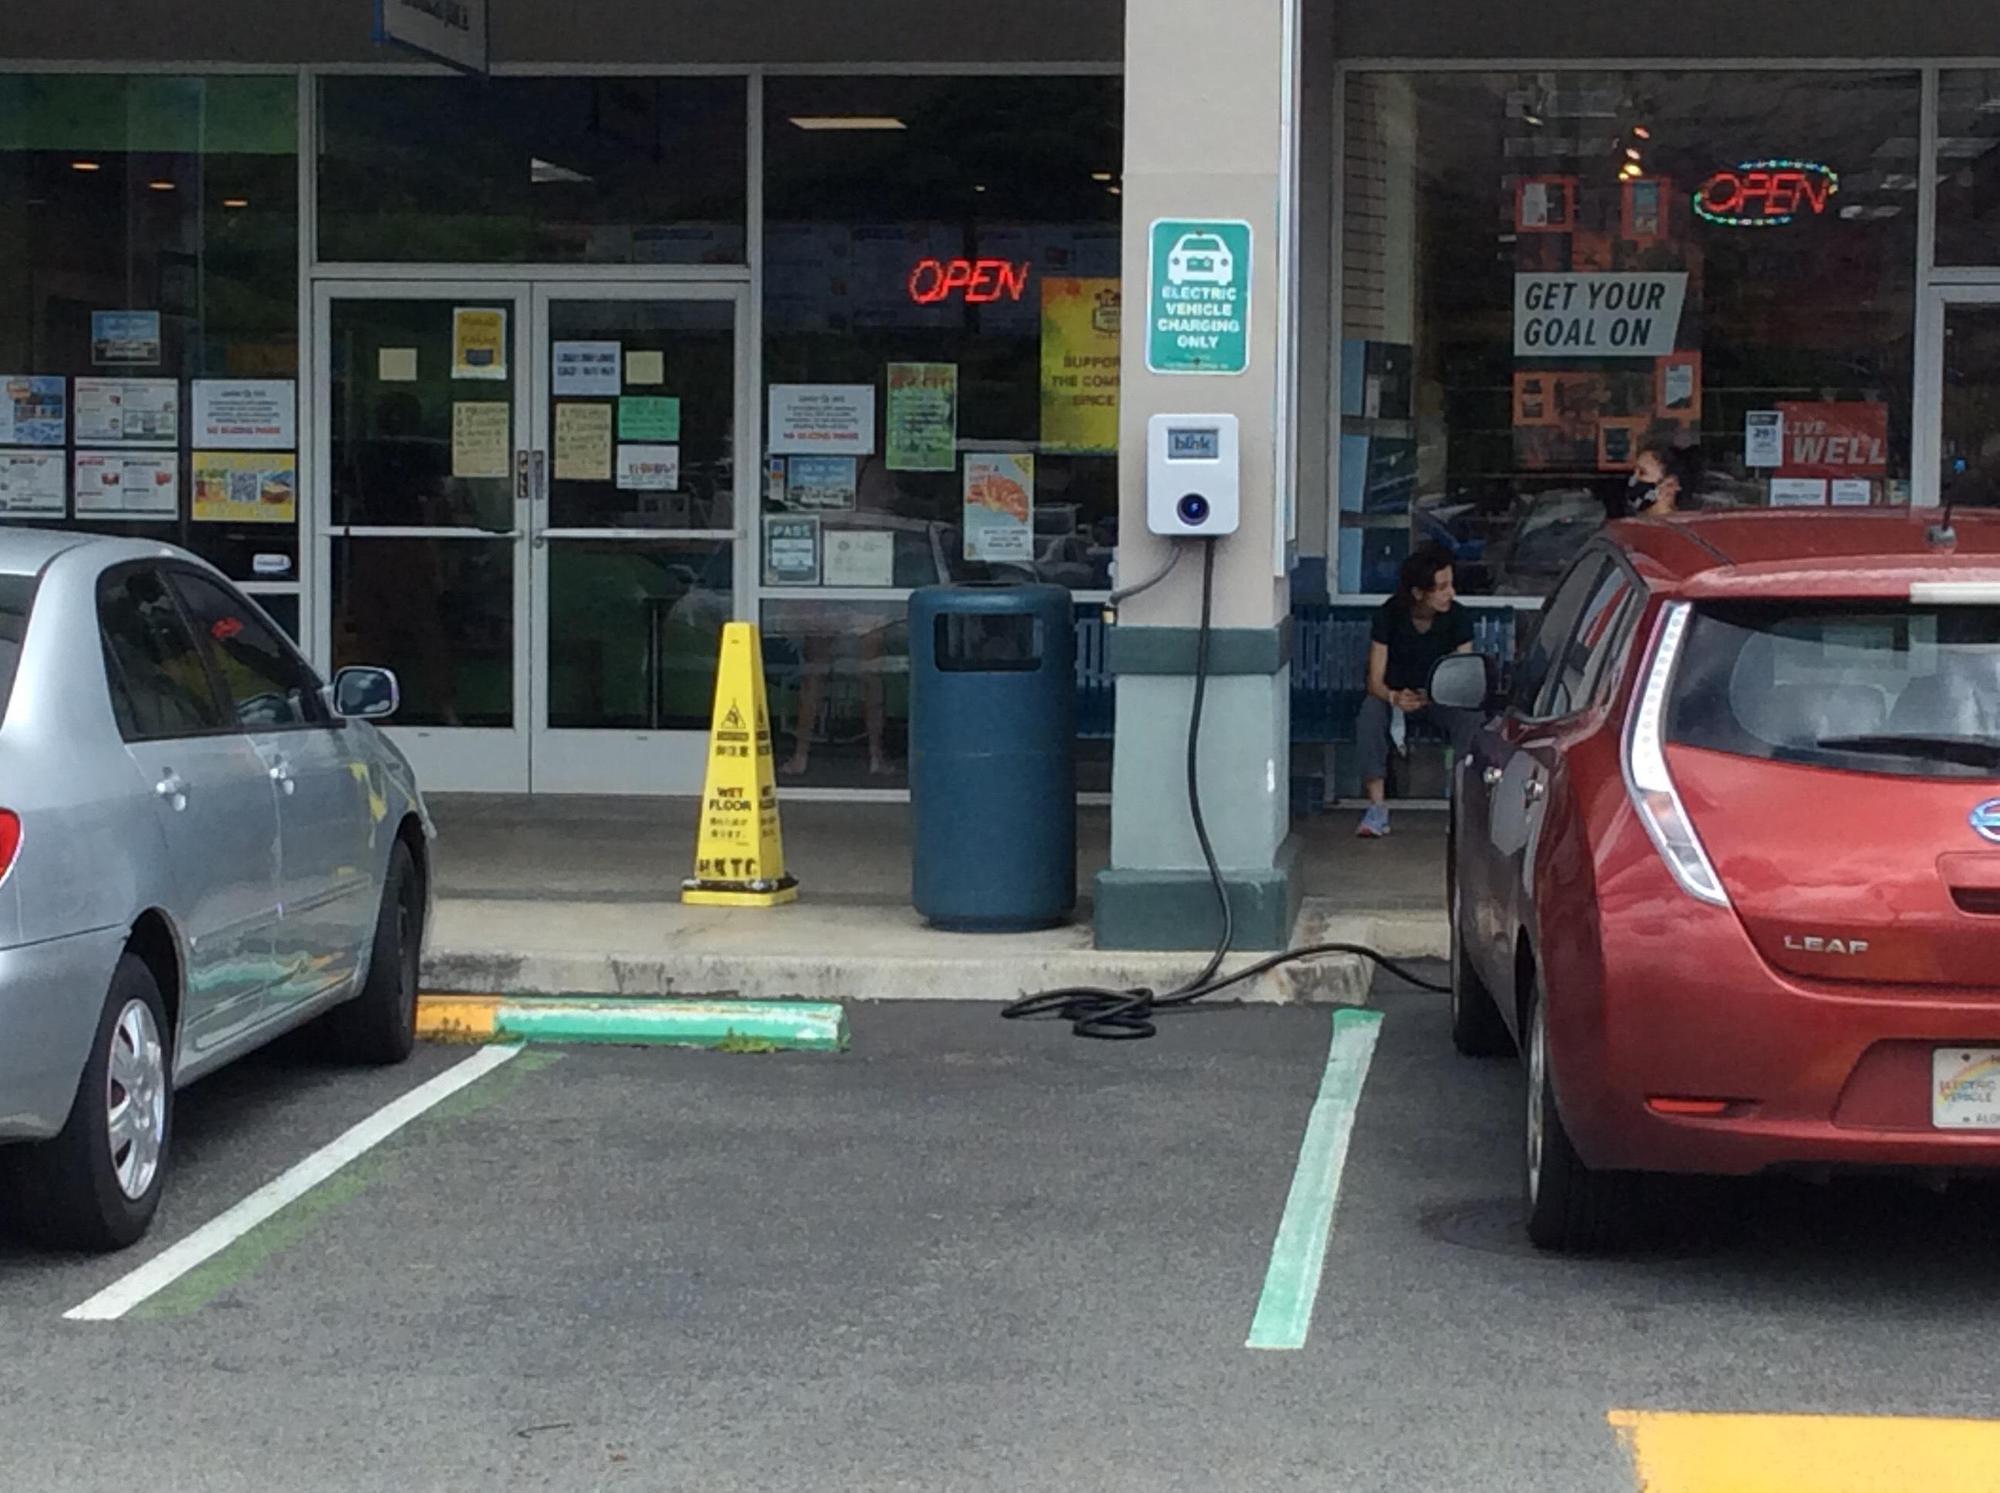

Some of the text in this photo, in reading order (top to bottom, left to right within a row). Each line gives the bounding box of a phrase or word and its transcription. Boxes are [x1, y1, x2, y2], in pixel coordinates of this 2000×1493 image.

[1700, 171, 1831, 215] OPEN
[908, 256, 1031, 304] OPEN
[1161, 286, 1237, 300] ELECTRIC
[1525, 282, 1665, 311] GET YOUR
[1165, 302, 1232, 316] VEHICLE
[1157, 318, 1240, 332] CHARGING
[1523, 318, 1652, 346] GOAL ON
[1177, 335, 1219, 348] ONLY
[1052, 375, 1078, 387] THE
[1782, 421, 1827, 435] LIVE
[1793, 436, 1887, 465] WELL
[717, 787, 744, 799] WET
[709, 799, 751, 812] FLOOR
[1783, 935, 1869, 954] LEAF
